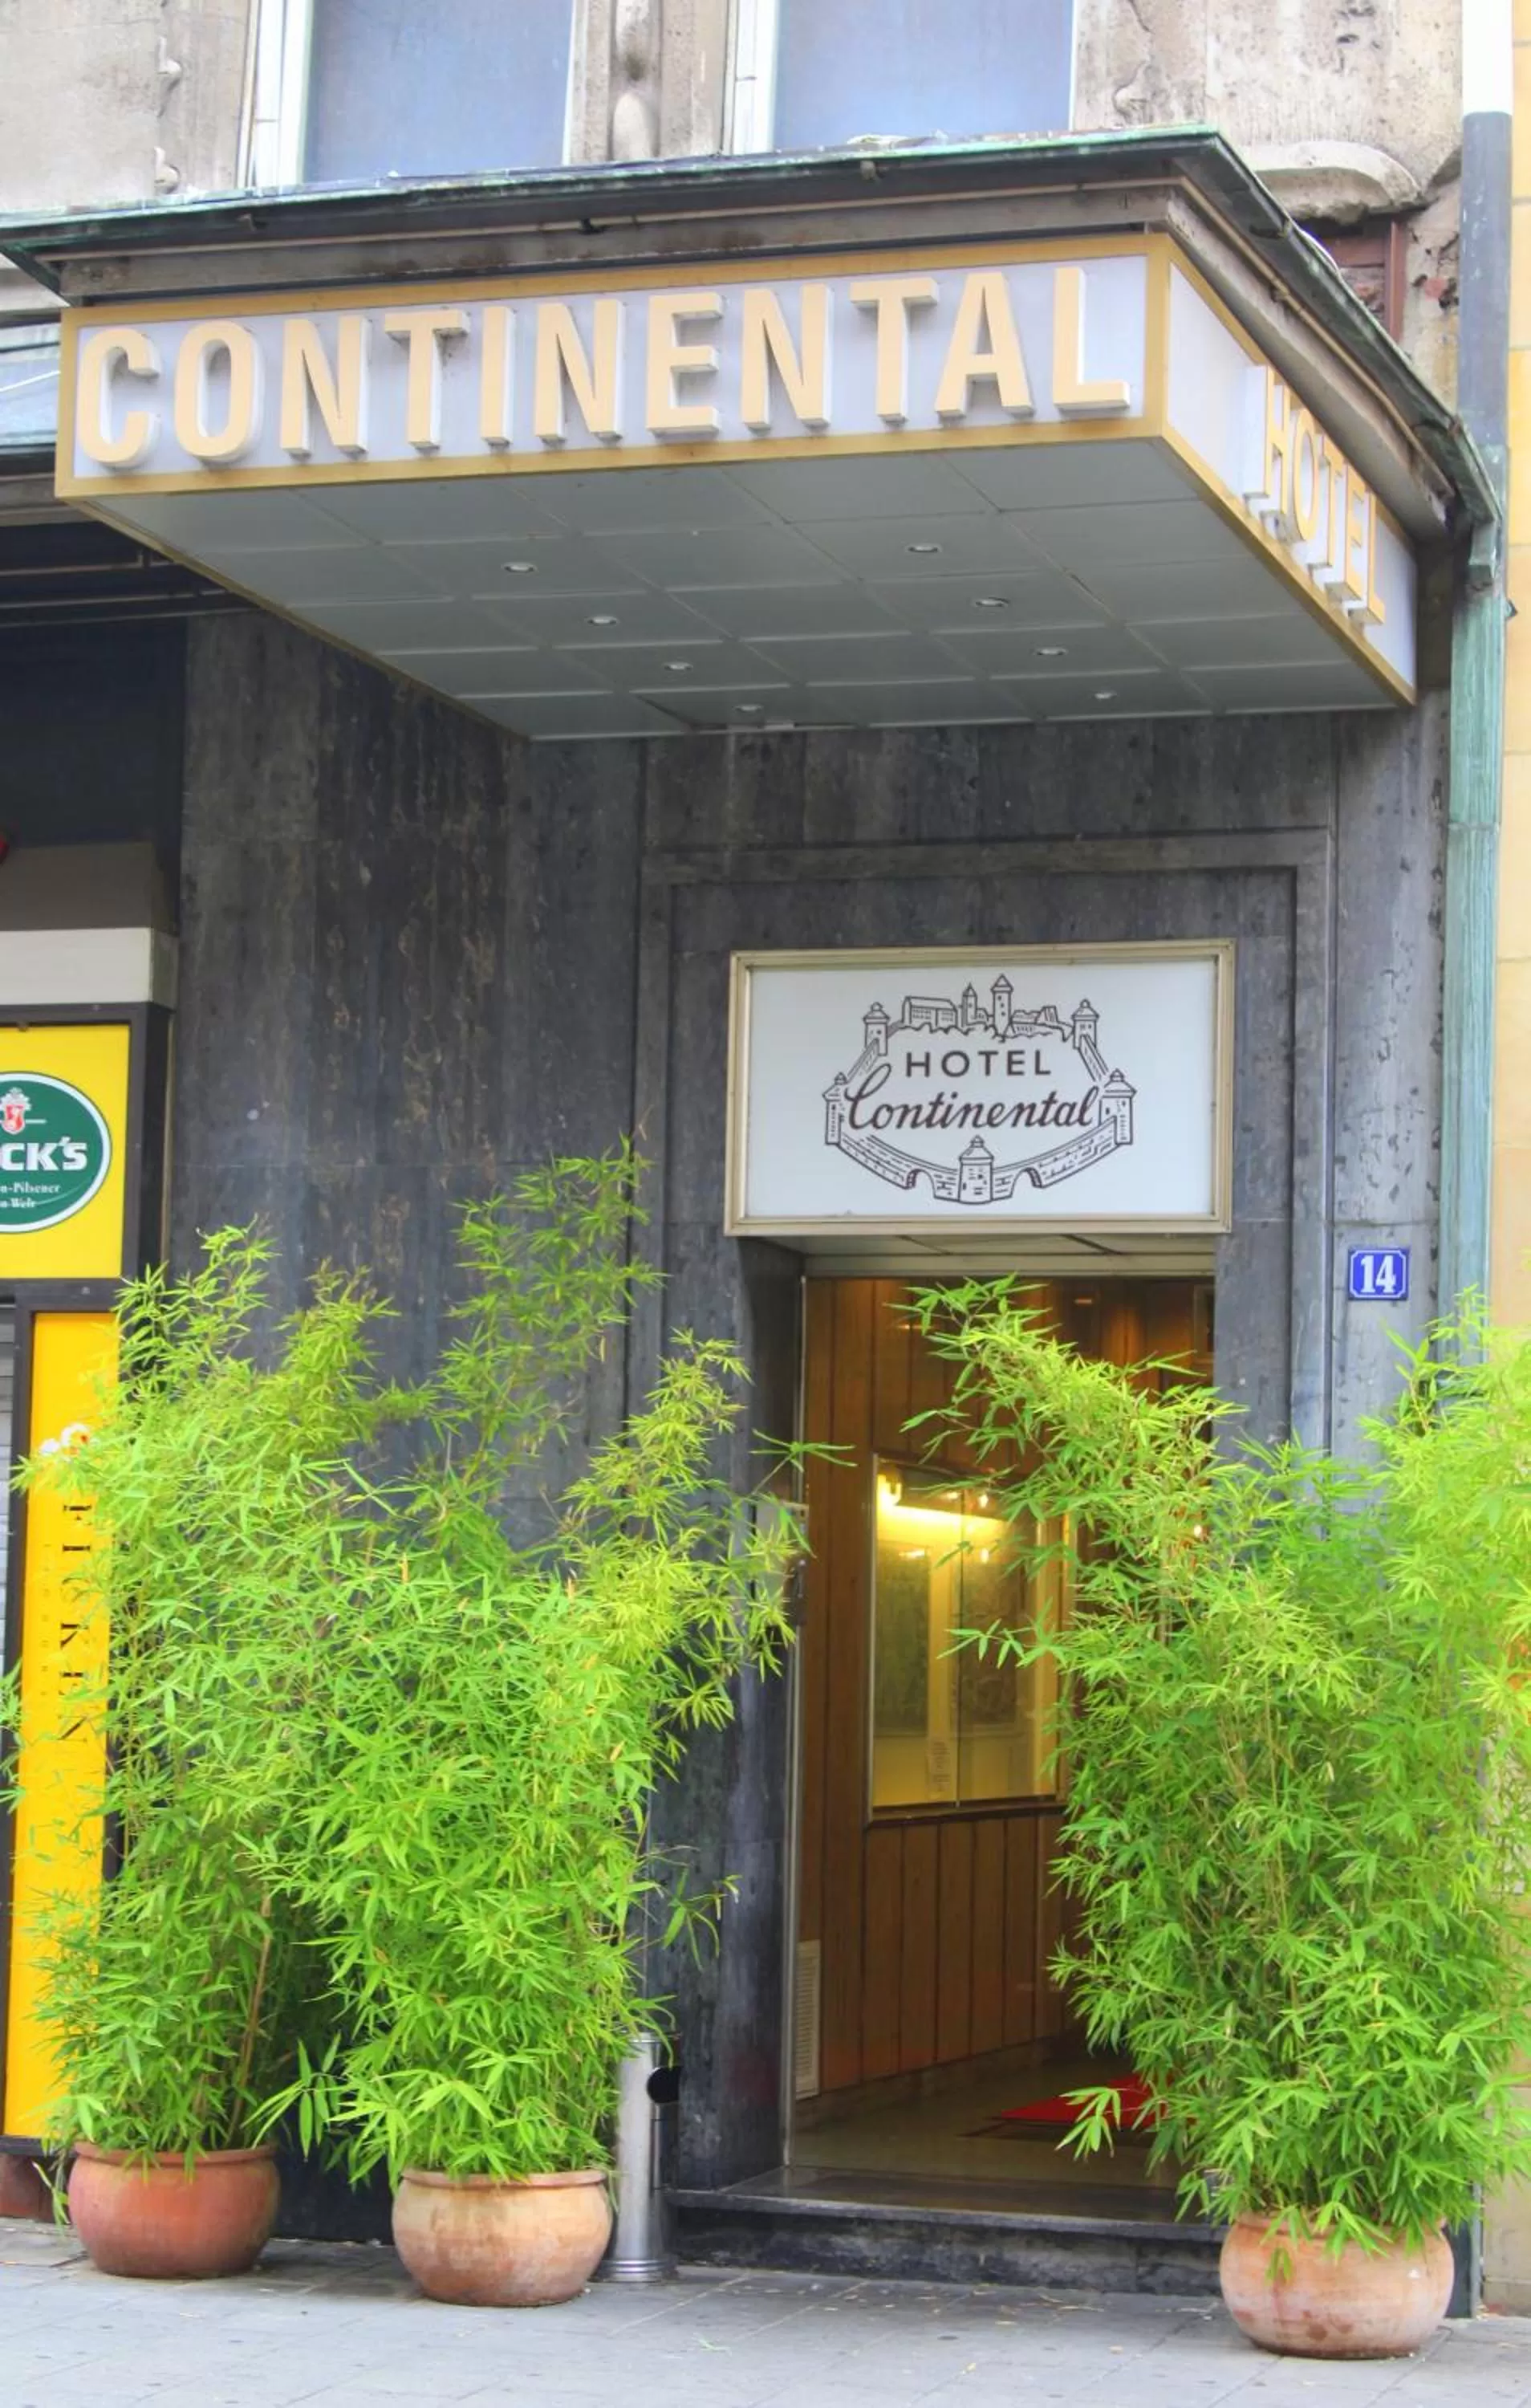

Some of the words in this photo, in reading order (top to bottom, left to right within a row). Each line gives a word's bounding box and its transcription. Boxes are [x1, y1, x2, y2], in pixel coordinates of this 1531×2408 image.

[79, 267, 1131, 469] CONTINENTAL
[1261, 365, 1386, 625] HOTEL
[844, 1064, 1099, 1130] Continental
[906, 1049, 1052, 1079] HOTEL
[1360, 1255, 1397, 1293] 14
